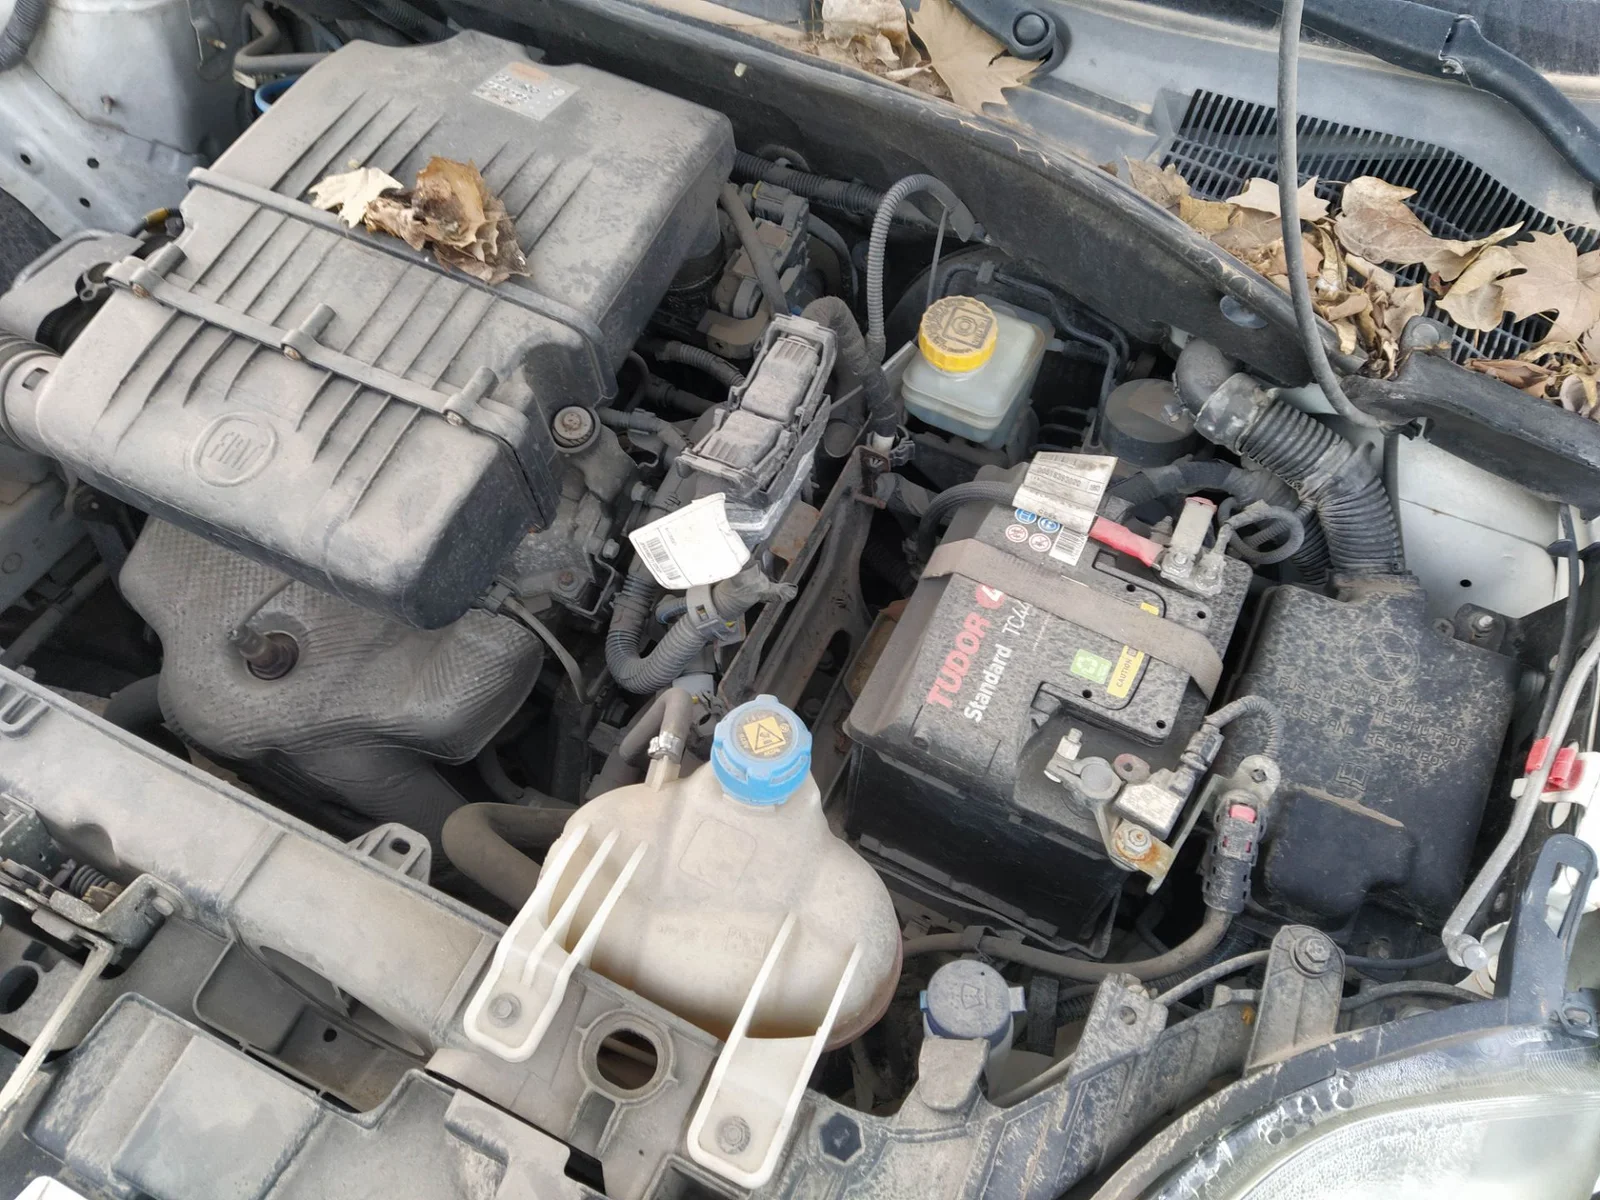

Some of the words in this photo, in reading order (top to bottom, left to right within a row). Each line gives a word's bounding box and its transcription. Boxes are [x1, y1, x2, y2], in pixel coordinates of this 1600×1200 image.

[927, 612, 990, 707] TUDOR
[963, 643, 1013, 722] Standard
[1115, 658, 1133, 688] CAUTION
[1331, 679, 1422, 716] CENTRALINA
[1281, 701, 1320, 725] FUSE
[1327, 718, 1356, 736] AND
[1366, 731, 1411, 757] RELAY
[1420, 751, 1451, 770] BOX
